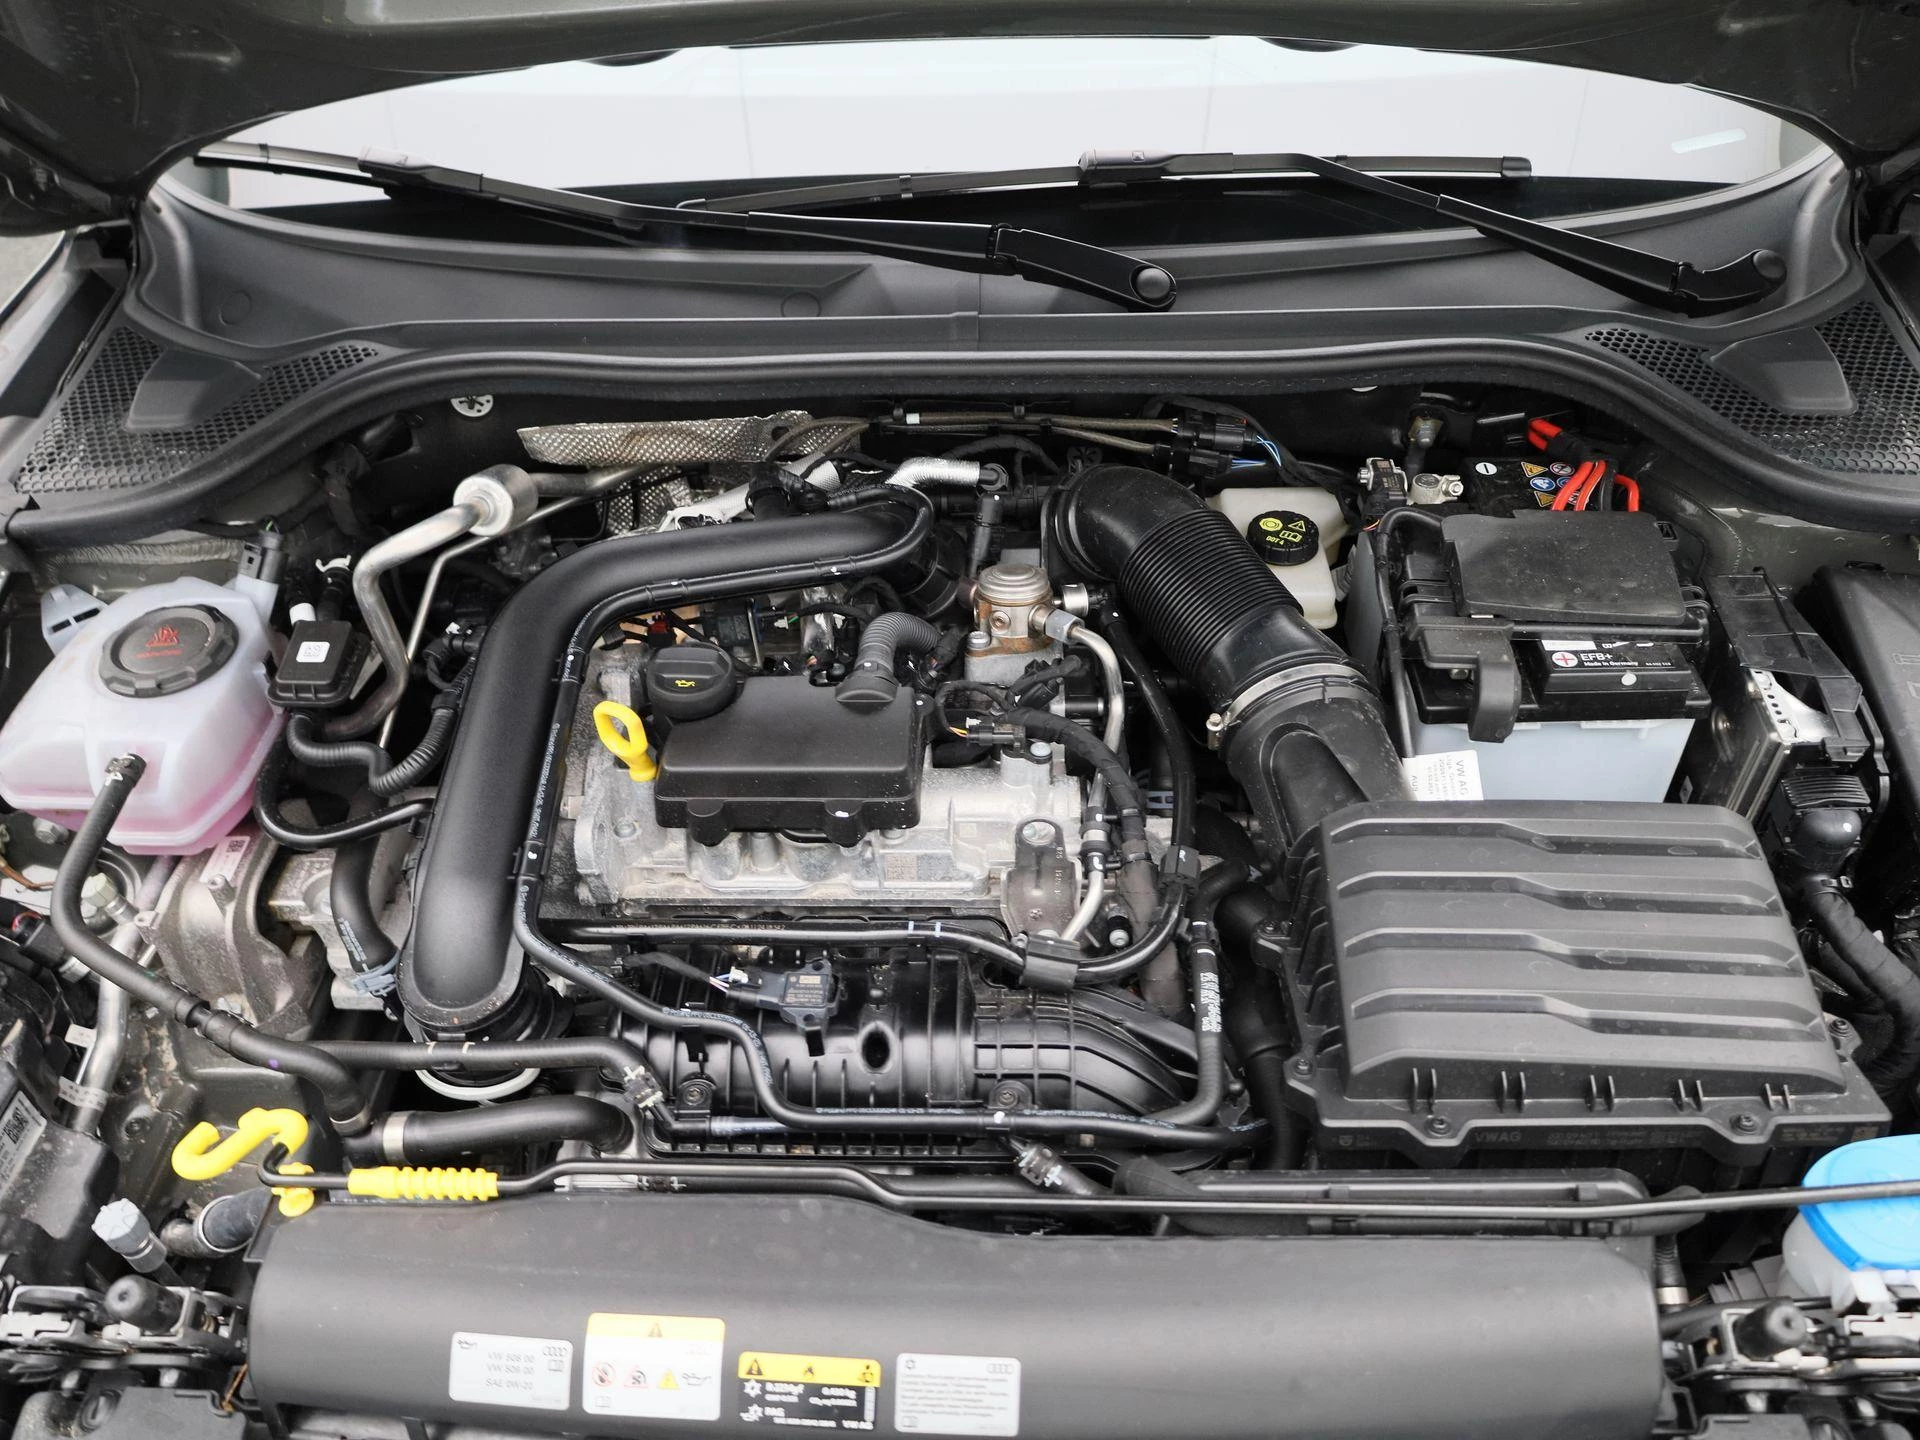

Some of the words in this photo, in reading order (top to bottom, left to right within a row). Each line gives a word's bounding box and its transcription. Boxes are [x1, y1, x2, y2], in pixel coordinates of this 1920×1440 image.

[1266, 535, 1280, 543] DOT
[1580, 652, 1613, 661] EFB+
[1456, 759, 1466, 777] VW
[1459, 780, 1469, 796] AG
